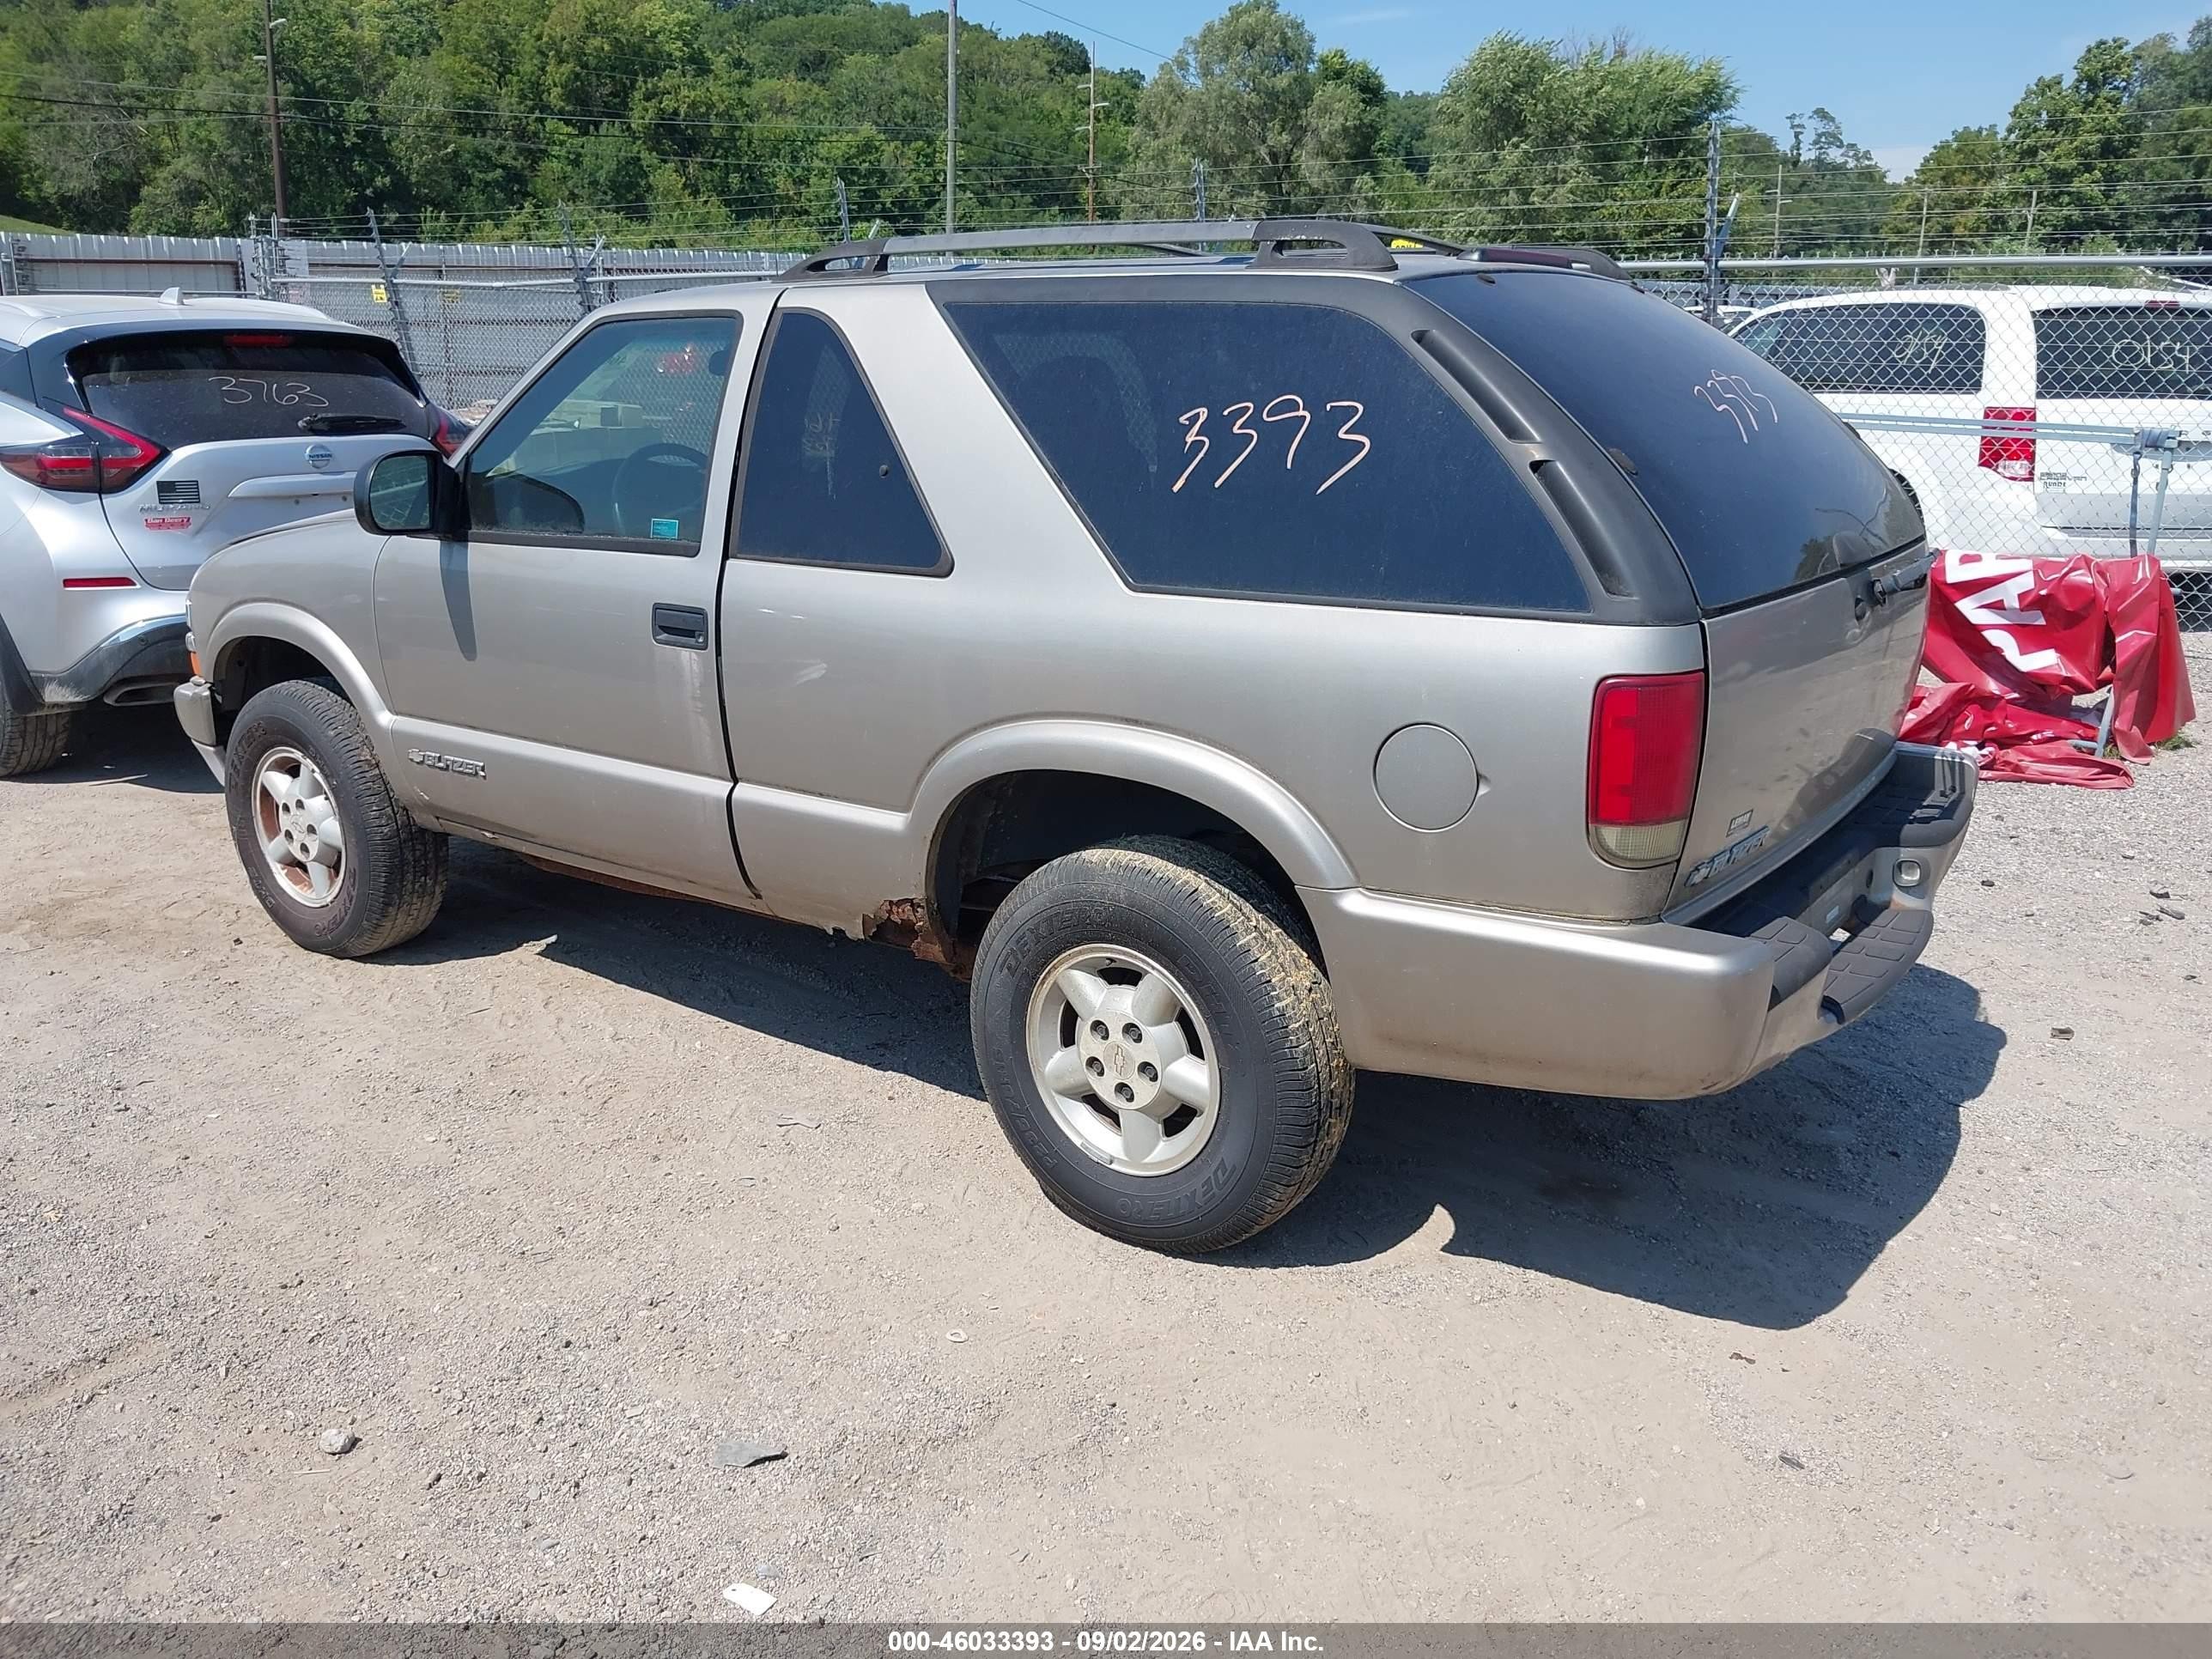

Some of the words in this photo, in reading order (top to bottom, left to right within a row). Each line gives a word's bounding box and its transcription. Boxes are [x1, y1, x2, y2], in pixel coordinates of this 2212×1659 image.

[2112, 337, 2189, 374] 0154
[208, 376, 329, 407] 3763
[1171, 394, 1371, 495] 3393
[425, 751, 486, 780] BLAZER
[1117, 1157, 1237, 1218] DEXTERO
